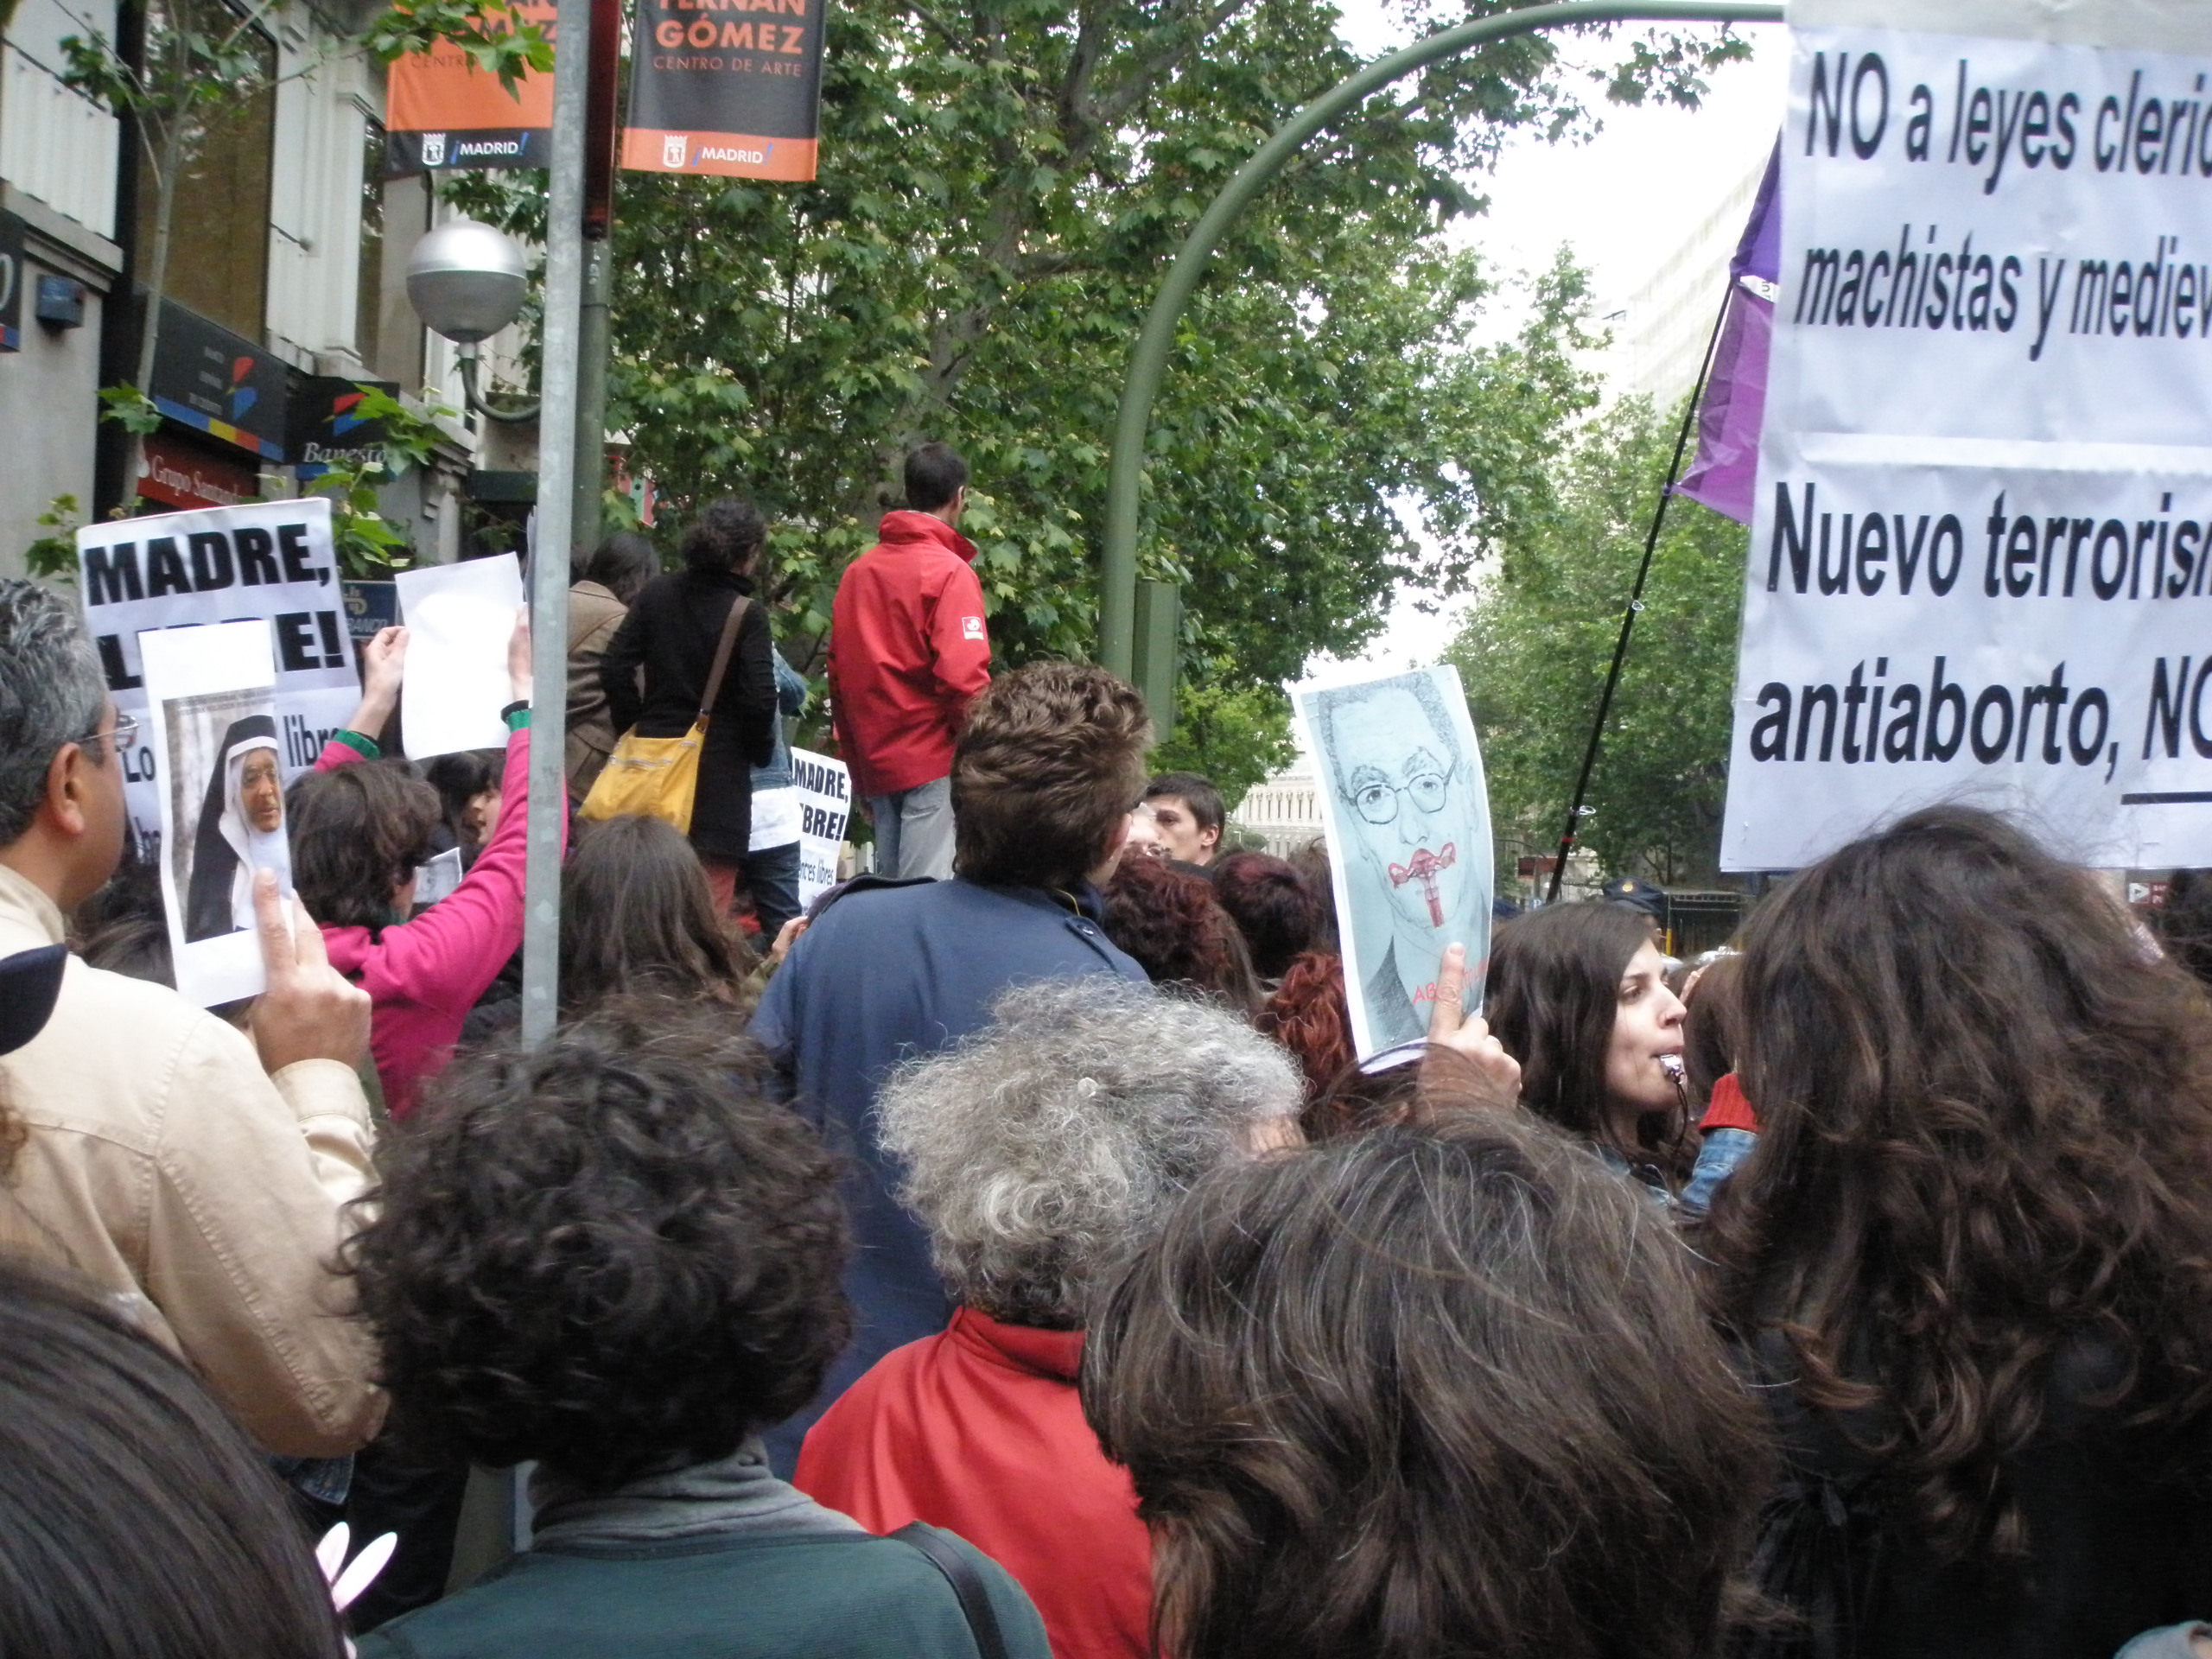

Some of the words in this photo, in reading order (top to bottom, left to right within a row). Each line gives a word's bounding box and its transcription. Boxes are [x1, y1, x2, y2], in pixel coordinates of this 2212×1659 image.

[411, 54, 467, 69] CENTR
[656, 12, 804, 54] GÓMEZ
[653, 55, 723, 71] CENTRO
[731, 57, 753, 73] DE
[760, 61, 802, 77] ARTE
[1805, 52, 1890, 161] NO
[1906, 83, 1934, 163] a
[1947, 60, 2081, 195] leyes
[1794, 223, 2022, 332] machistas
[2029, 257, 2065, 361] y
[84, 523, 330, 606] MADRE,
[1767, 481, 1964, 597] Nuevo
[1749, 655, 2120, 785] antiaborto,
[794, 757, 849, 804] MADRE,
[799, 802, 847, 842] BRE!
